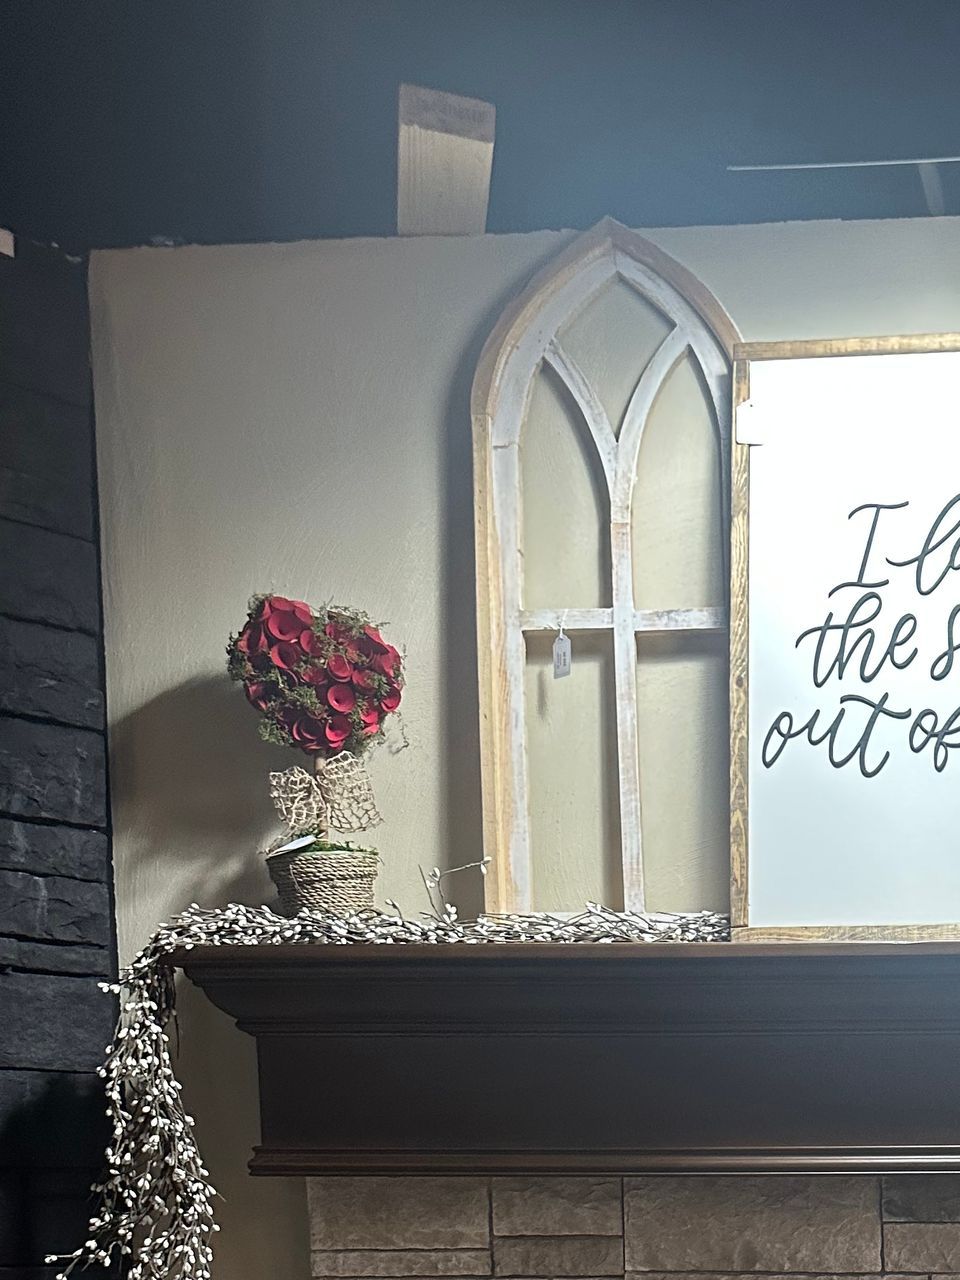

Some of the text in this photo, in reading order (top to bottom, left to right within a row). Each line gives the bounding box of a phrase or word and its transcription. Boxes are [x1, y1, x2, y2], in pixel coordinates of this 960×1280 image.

[828, 501, 909, 598] I
[795, 591, 917, 688] the
[762, 692, 911, 778] out
